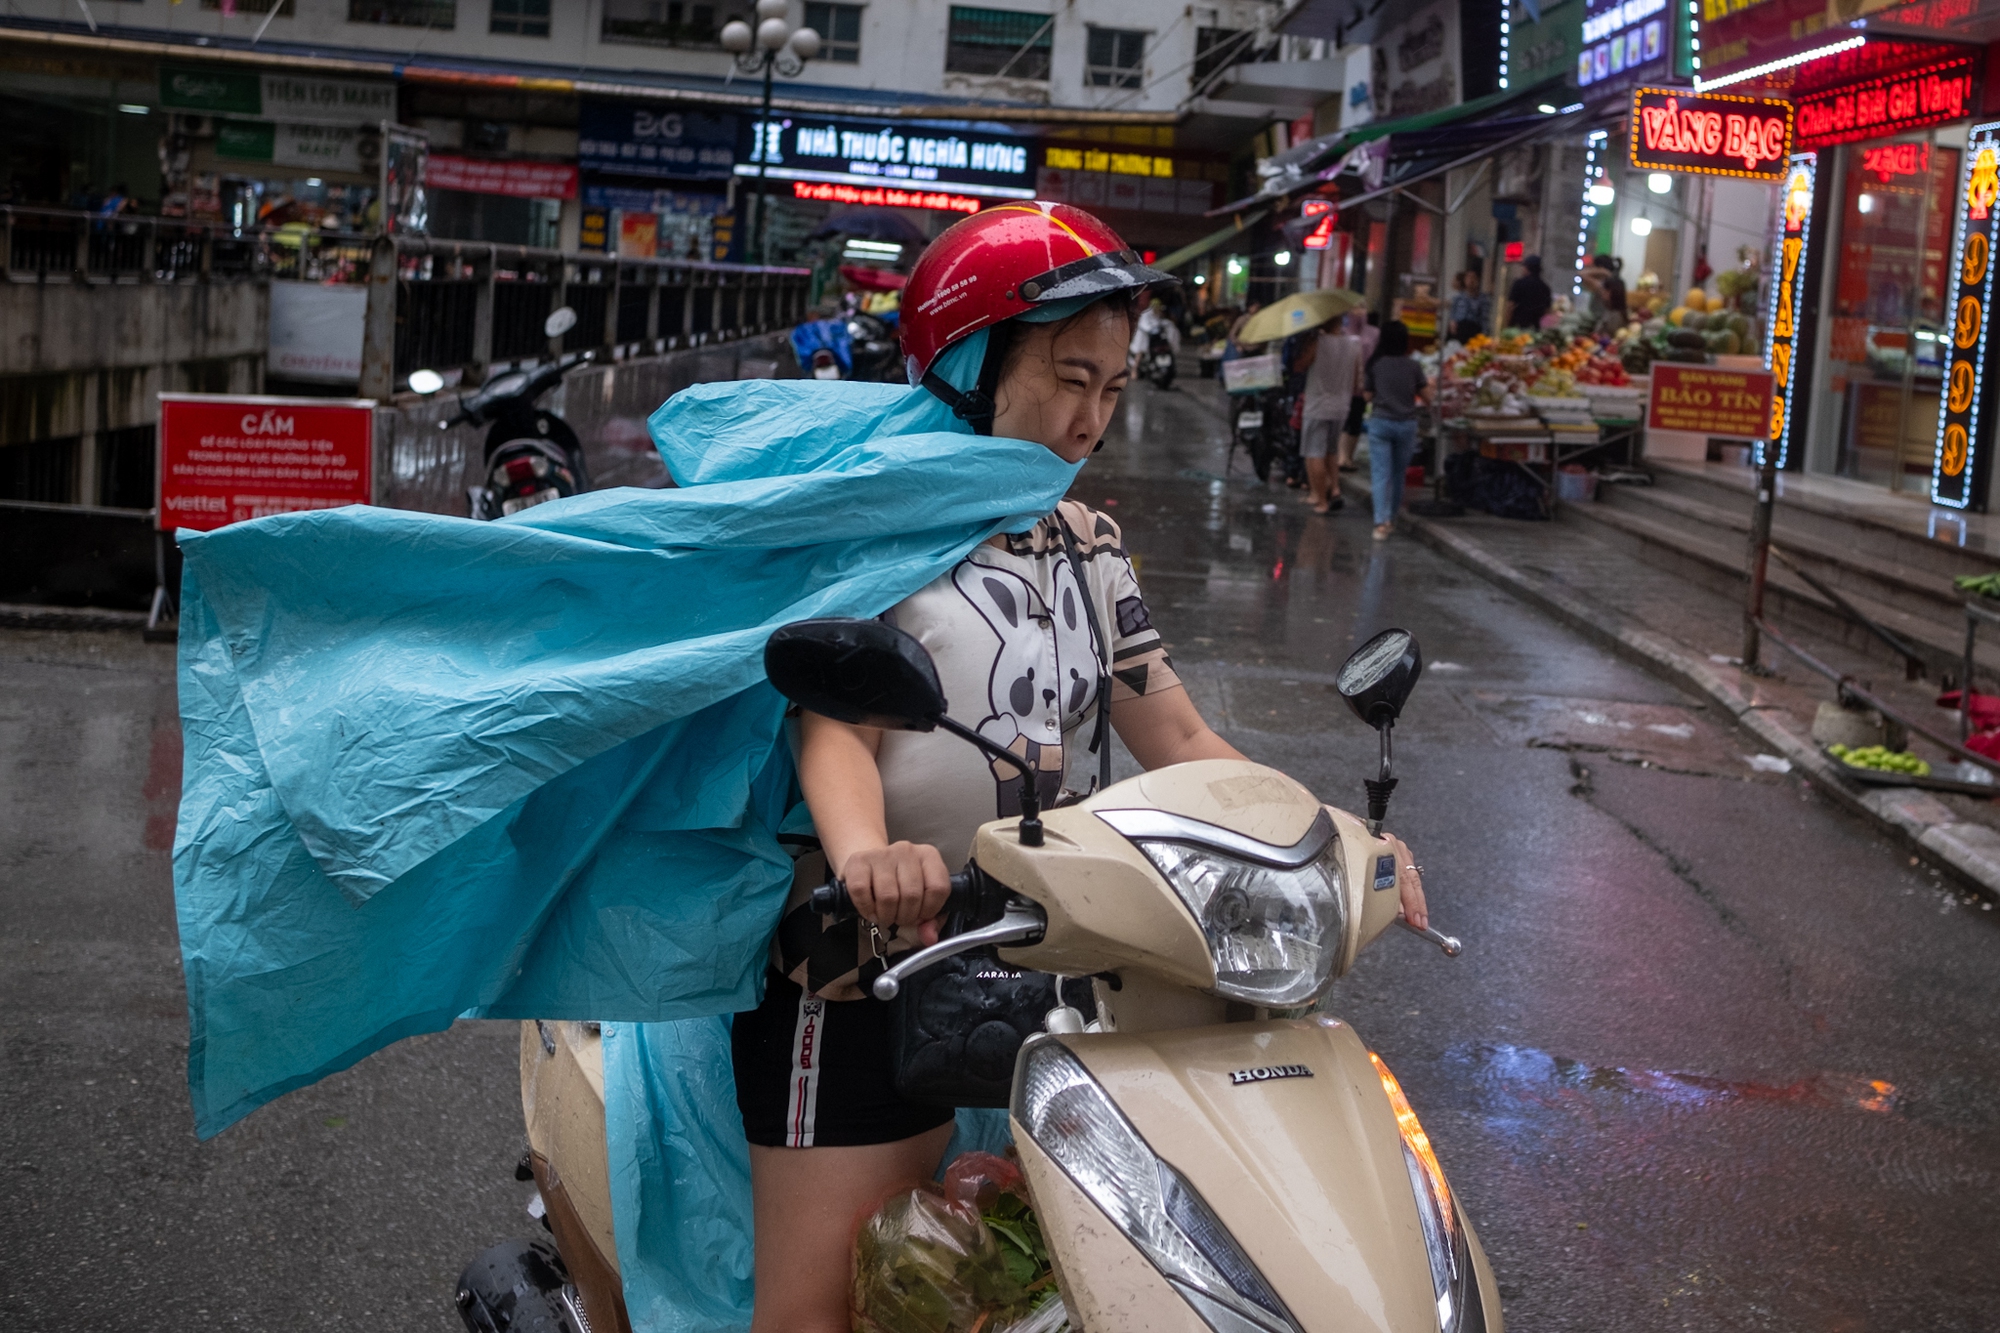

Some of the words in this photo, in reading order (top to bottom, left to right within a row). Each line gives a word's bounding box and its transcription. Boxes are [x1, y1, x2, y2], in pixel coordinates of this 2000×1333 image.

[797, 125, 838, 157] NHÀ
[840, 127, 905, 163] THUỐC
[907, 135, 968, 169] NGHĨA
[970, 142, 1028, 174] HƯNG
[1724, 114, 1785, 170] BẠC
[1660, 383, 1713, 407] BẢO
[1717, 388, 1763, 410] TÍN
[240, 409, 295, 436] CẤM
[165, 494, 228, 513] viettel
[1233, 1065, 1314, 1085] HONDA
